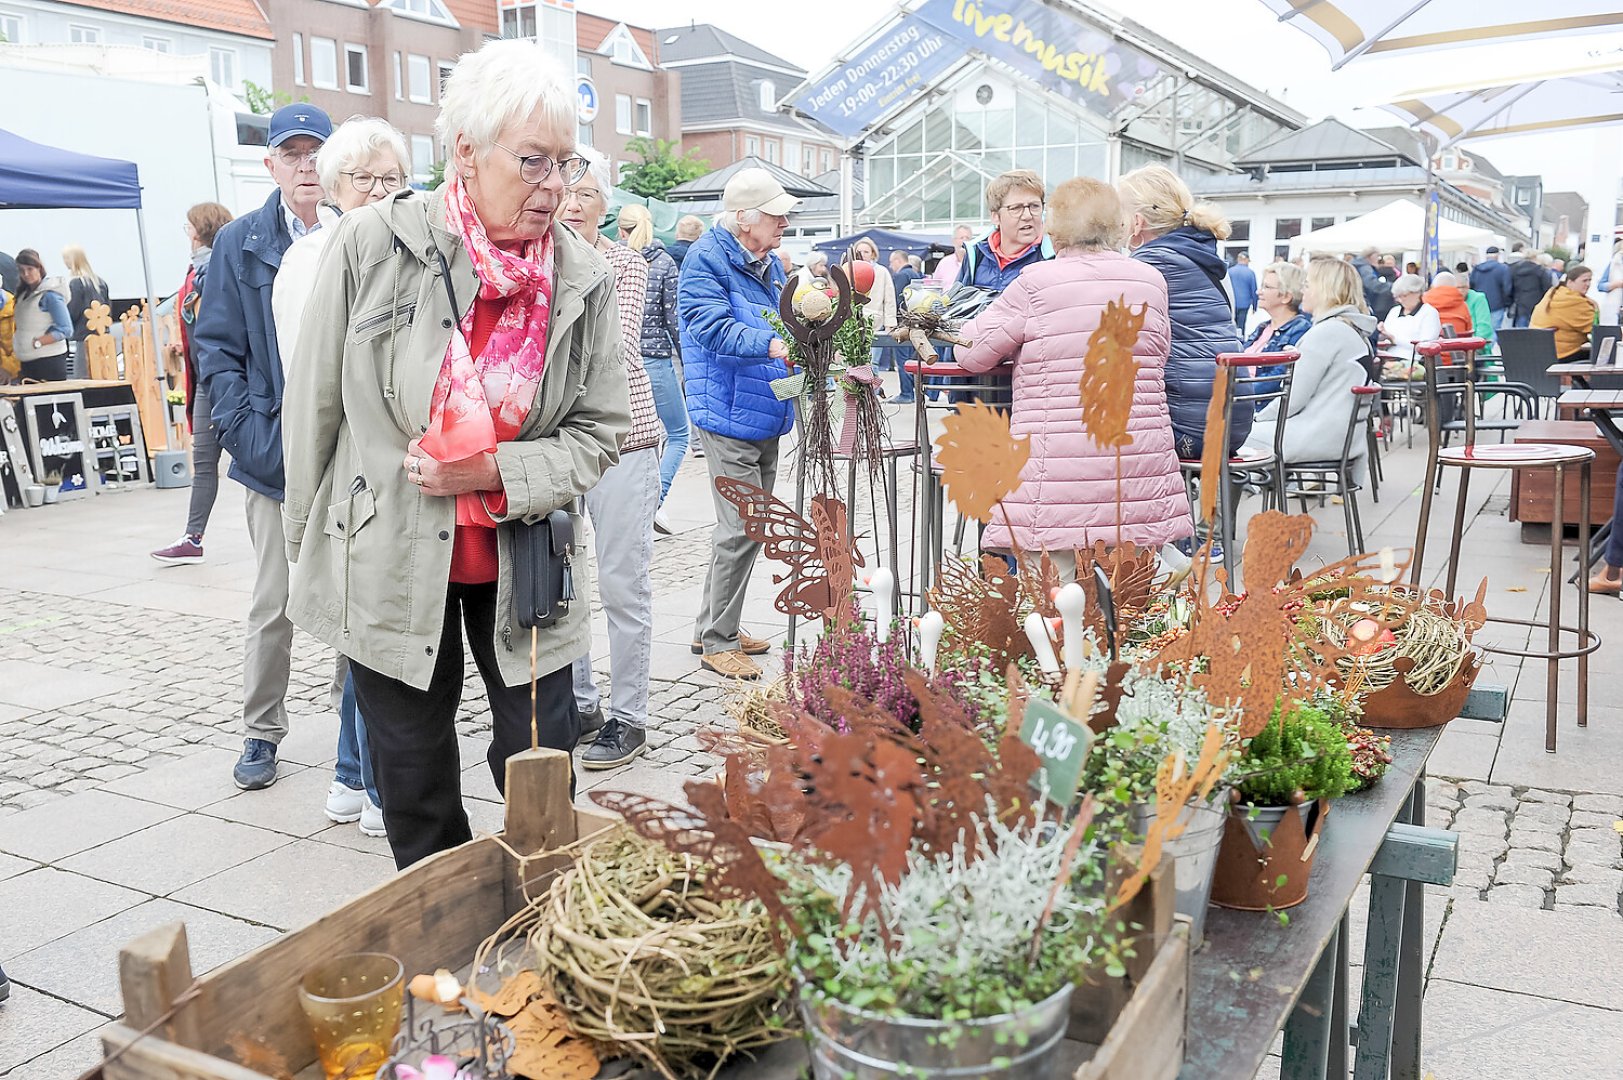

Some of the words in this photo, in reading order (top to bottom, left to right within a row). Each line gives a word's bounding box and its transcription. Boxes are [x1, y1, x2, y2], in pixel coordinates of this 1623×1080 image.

[917, 35, 943, 58] Uhr
[807, 78, 848, 112] Jeden
[845, 25, 920, 82] Donnerstag
[88, 425, 118, 438] HOME
